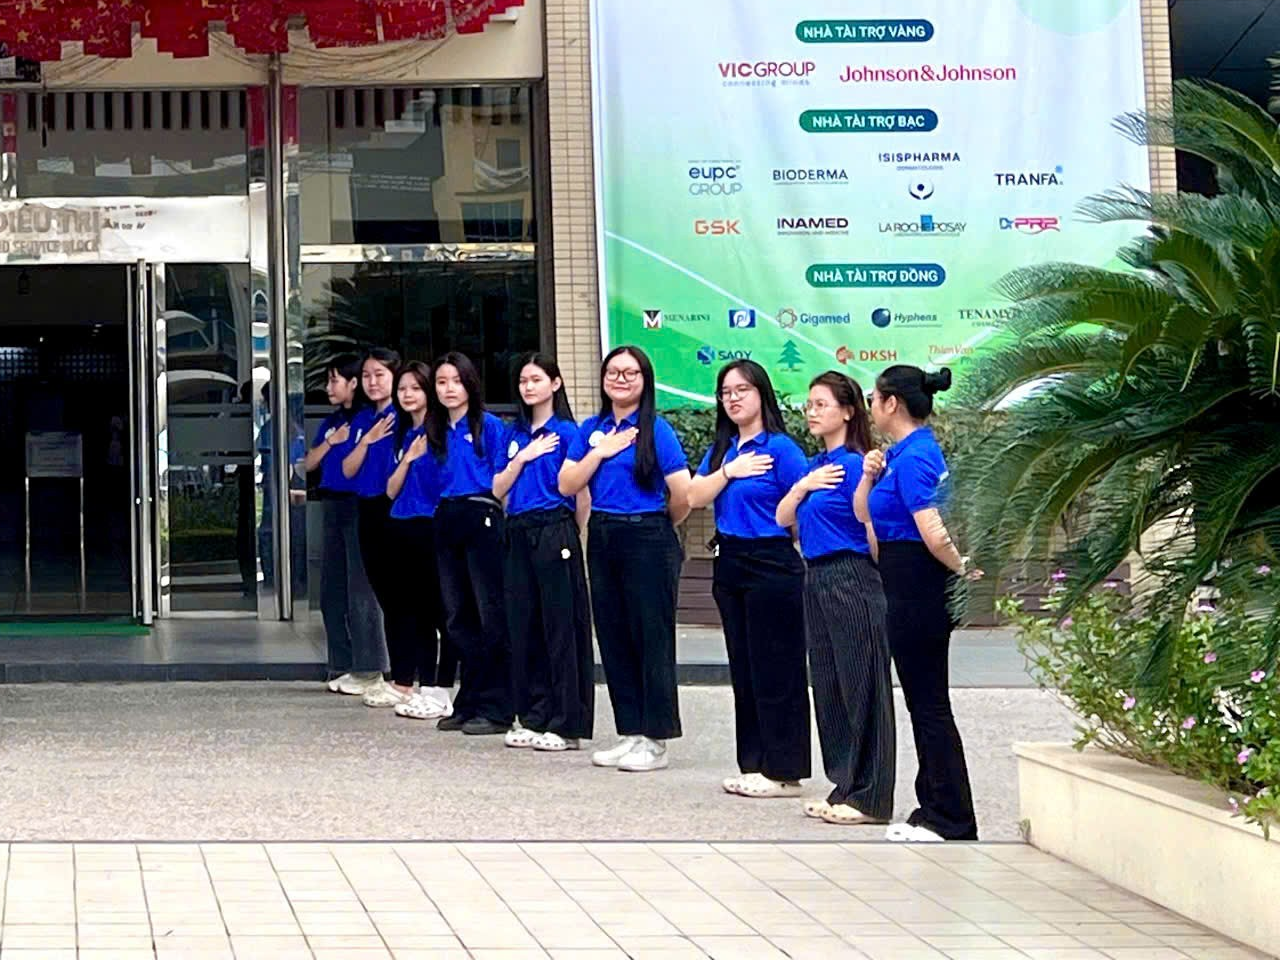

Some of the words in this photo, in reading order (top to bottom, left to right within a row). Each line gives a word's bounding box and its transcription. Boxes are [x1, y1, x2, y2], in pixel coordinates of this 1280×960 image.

[804, 24, 833, 39] NHÀ
[835, 23, 857, 38] TÀI
[859, 25, 887, 40] TRỢ
[888, 24, 926, 38] VÀNG
[718, 62, 816, 78] VICGROUP
[840, 64, 1017, 83] Johnson&Johnson
[812, 115, 841, 128] NHÀ
[844, 114, 865, 128] TÀI
[867, 114, 895, 129] TRỢ
[898, 115, 925, 131] BẠC
[878, 152, 961, 163] ISISPHARMA
[772, 169, 849, 181] BIODERMA
[688, 182, 742, 196] GROUP
[694, 219, 741, 235] GSK
[777, 217, 849, 229] INAMED
[814, 268, 844, 283] NHÀ
[846, 267, 868, 282] TÀI
[870, 268, 897, 284] TRỢ
[900, 265, 939, 282] ĐỒNG
[800, 312, 850, 327] Gigamed
[859, 350, 897, 361] DKSH
